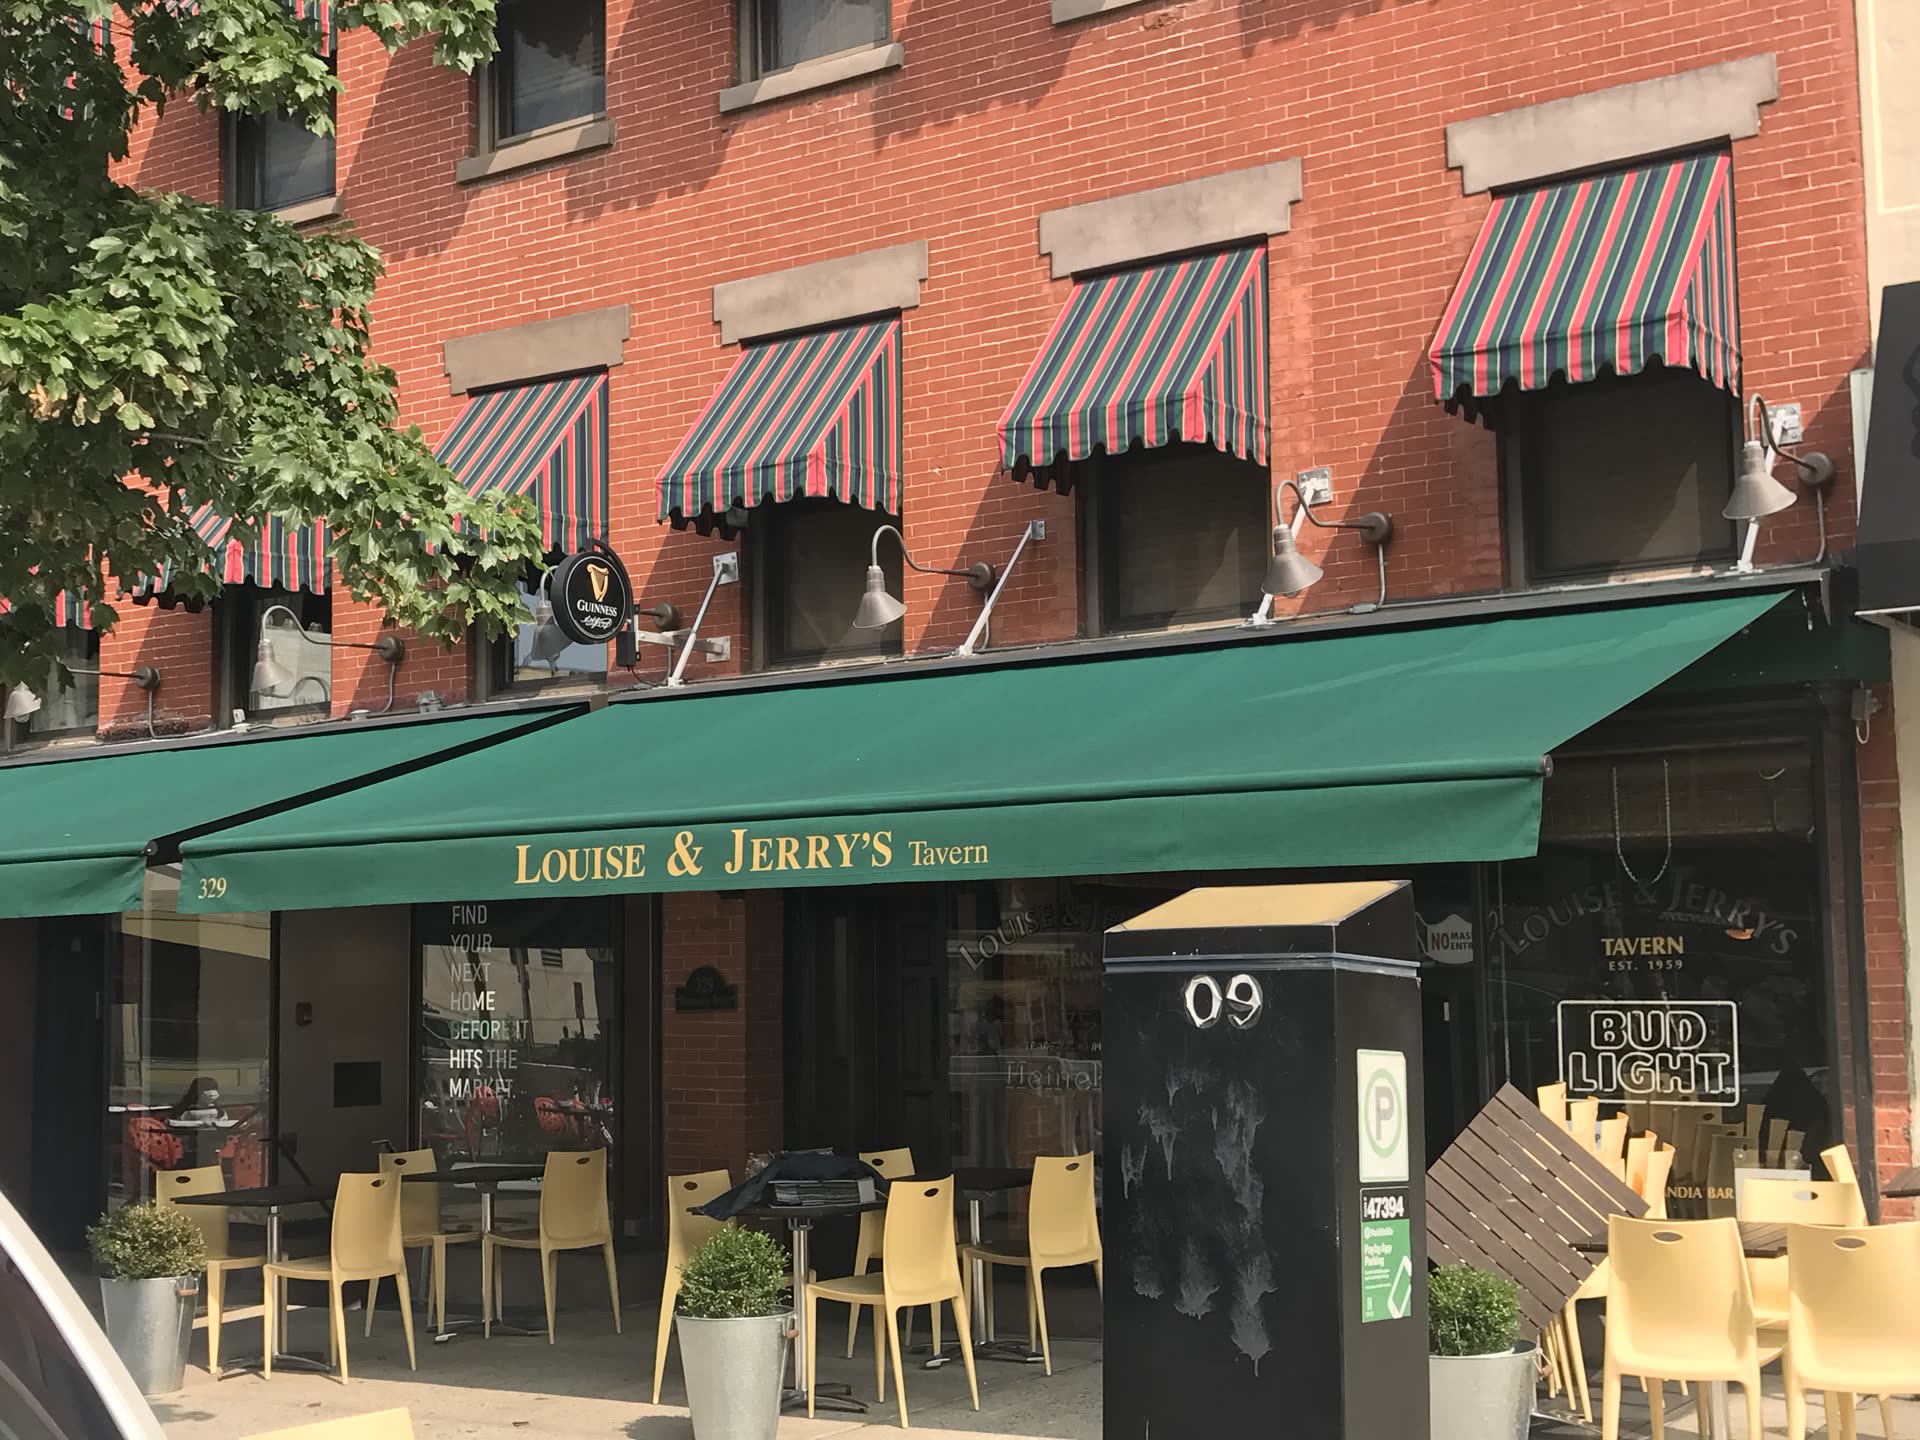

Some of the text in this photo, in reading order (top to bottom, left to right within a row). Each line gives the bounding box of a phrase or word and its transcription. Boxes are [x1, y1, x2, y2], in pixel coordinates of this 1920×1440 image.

[577, 599, 617, 616] GUINNESS
[514, 830, 989, 884] LOUISE & JERRY'S Tavern
[198, 877, 227, 899] 329
[452, 905, 487, 924] FIND
[1497, 866, 1798, 958] LOUISE & JERRY'S
[451, 934, 492, 953] YOUR
[958, 905, 1058, 972] LOUISE
[1431, 932, 1450, 951] NO
[1601, 936, 1684, 956] TAVERN
[451, 963, 491, 982] NEXT
[1608, 959, 1683, 971] EST. 1959
[450, 991, 496, 1011] HOME
[1183, 974, 1263, 1029] 09
[450, 1020, 510, 1040] BEFORE
[1591, 1010, 1707, 1050] BUD
[450, 1049, 518, 1069] HITS THE
[1707, 1187, 1734, 1199] BAR
